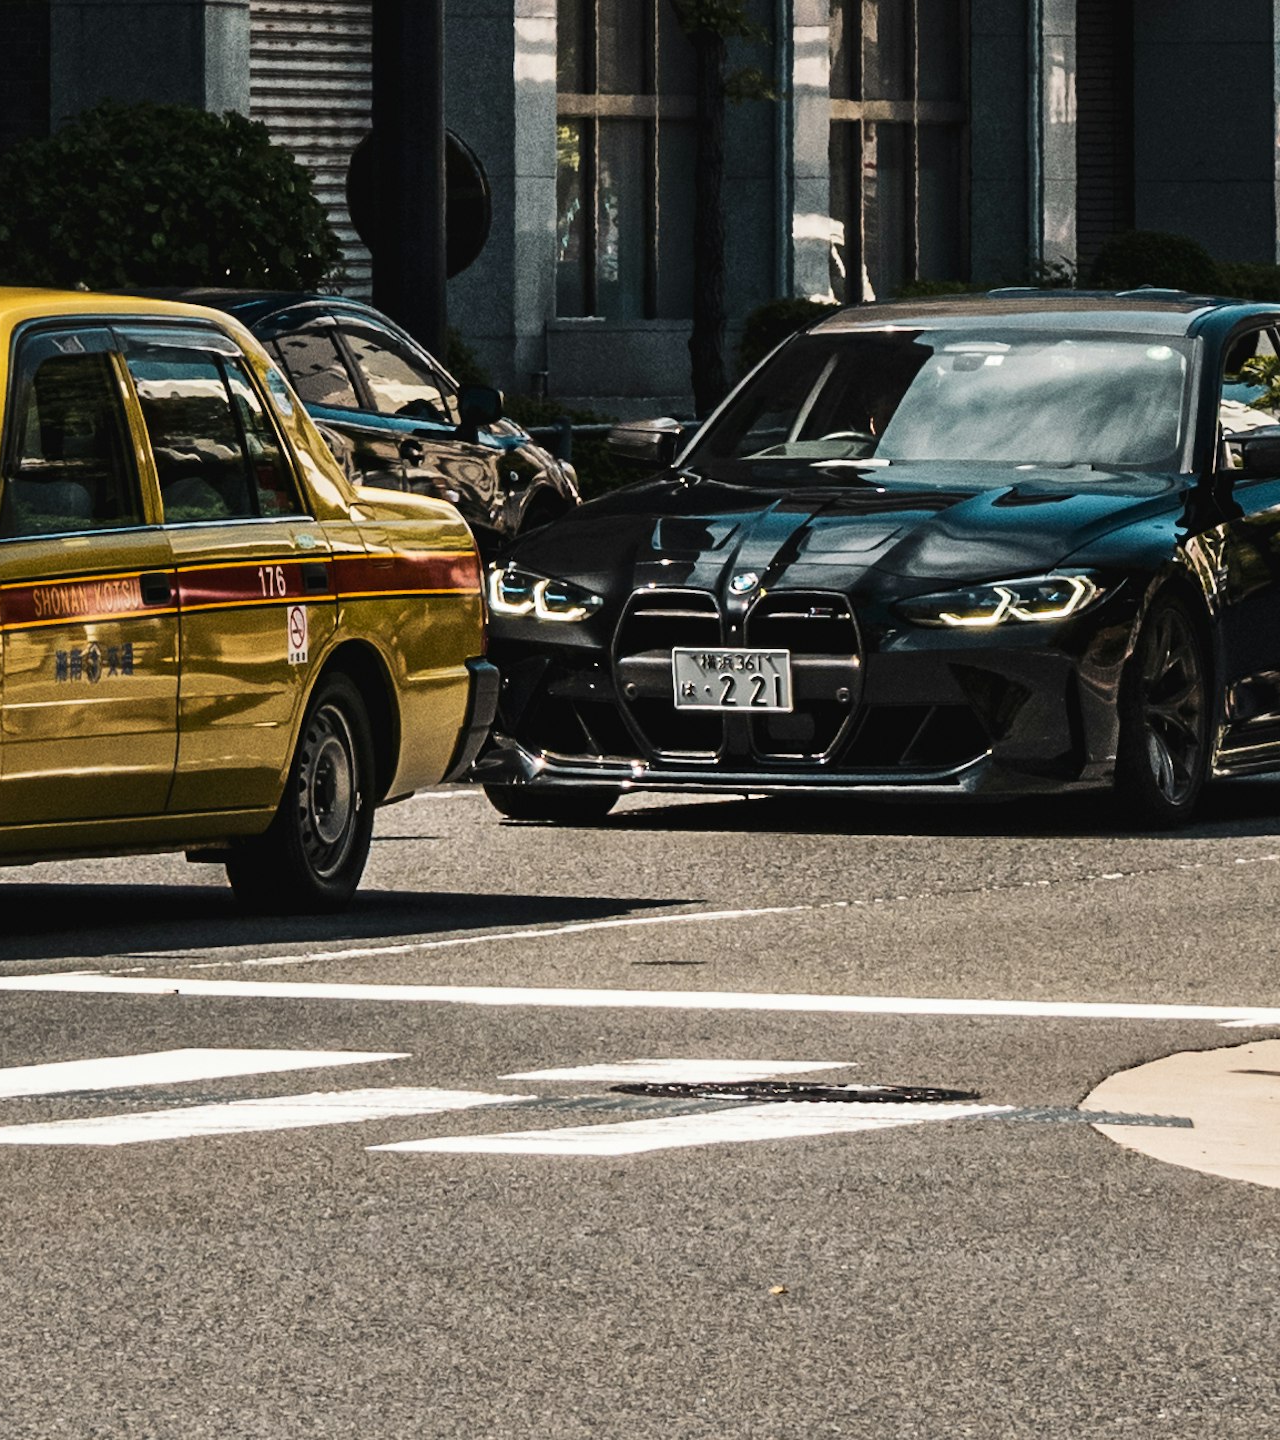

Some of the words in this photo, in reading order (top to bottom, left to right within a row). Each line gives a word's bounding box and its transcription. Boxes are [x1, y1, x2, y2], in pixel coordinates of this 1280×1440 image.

[32, 585, 89, 618] SHONAN
[94, 578, 140, 612] KOTSU
[258, 565, 286, 597] 176
